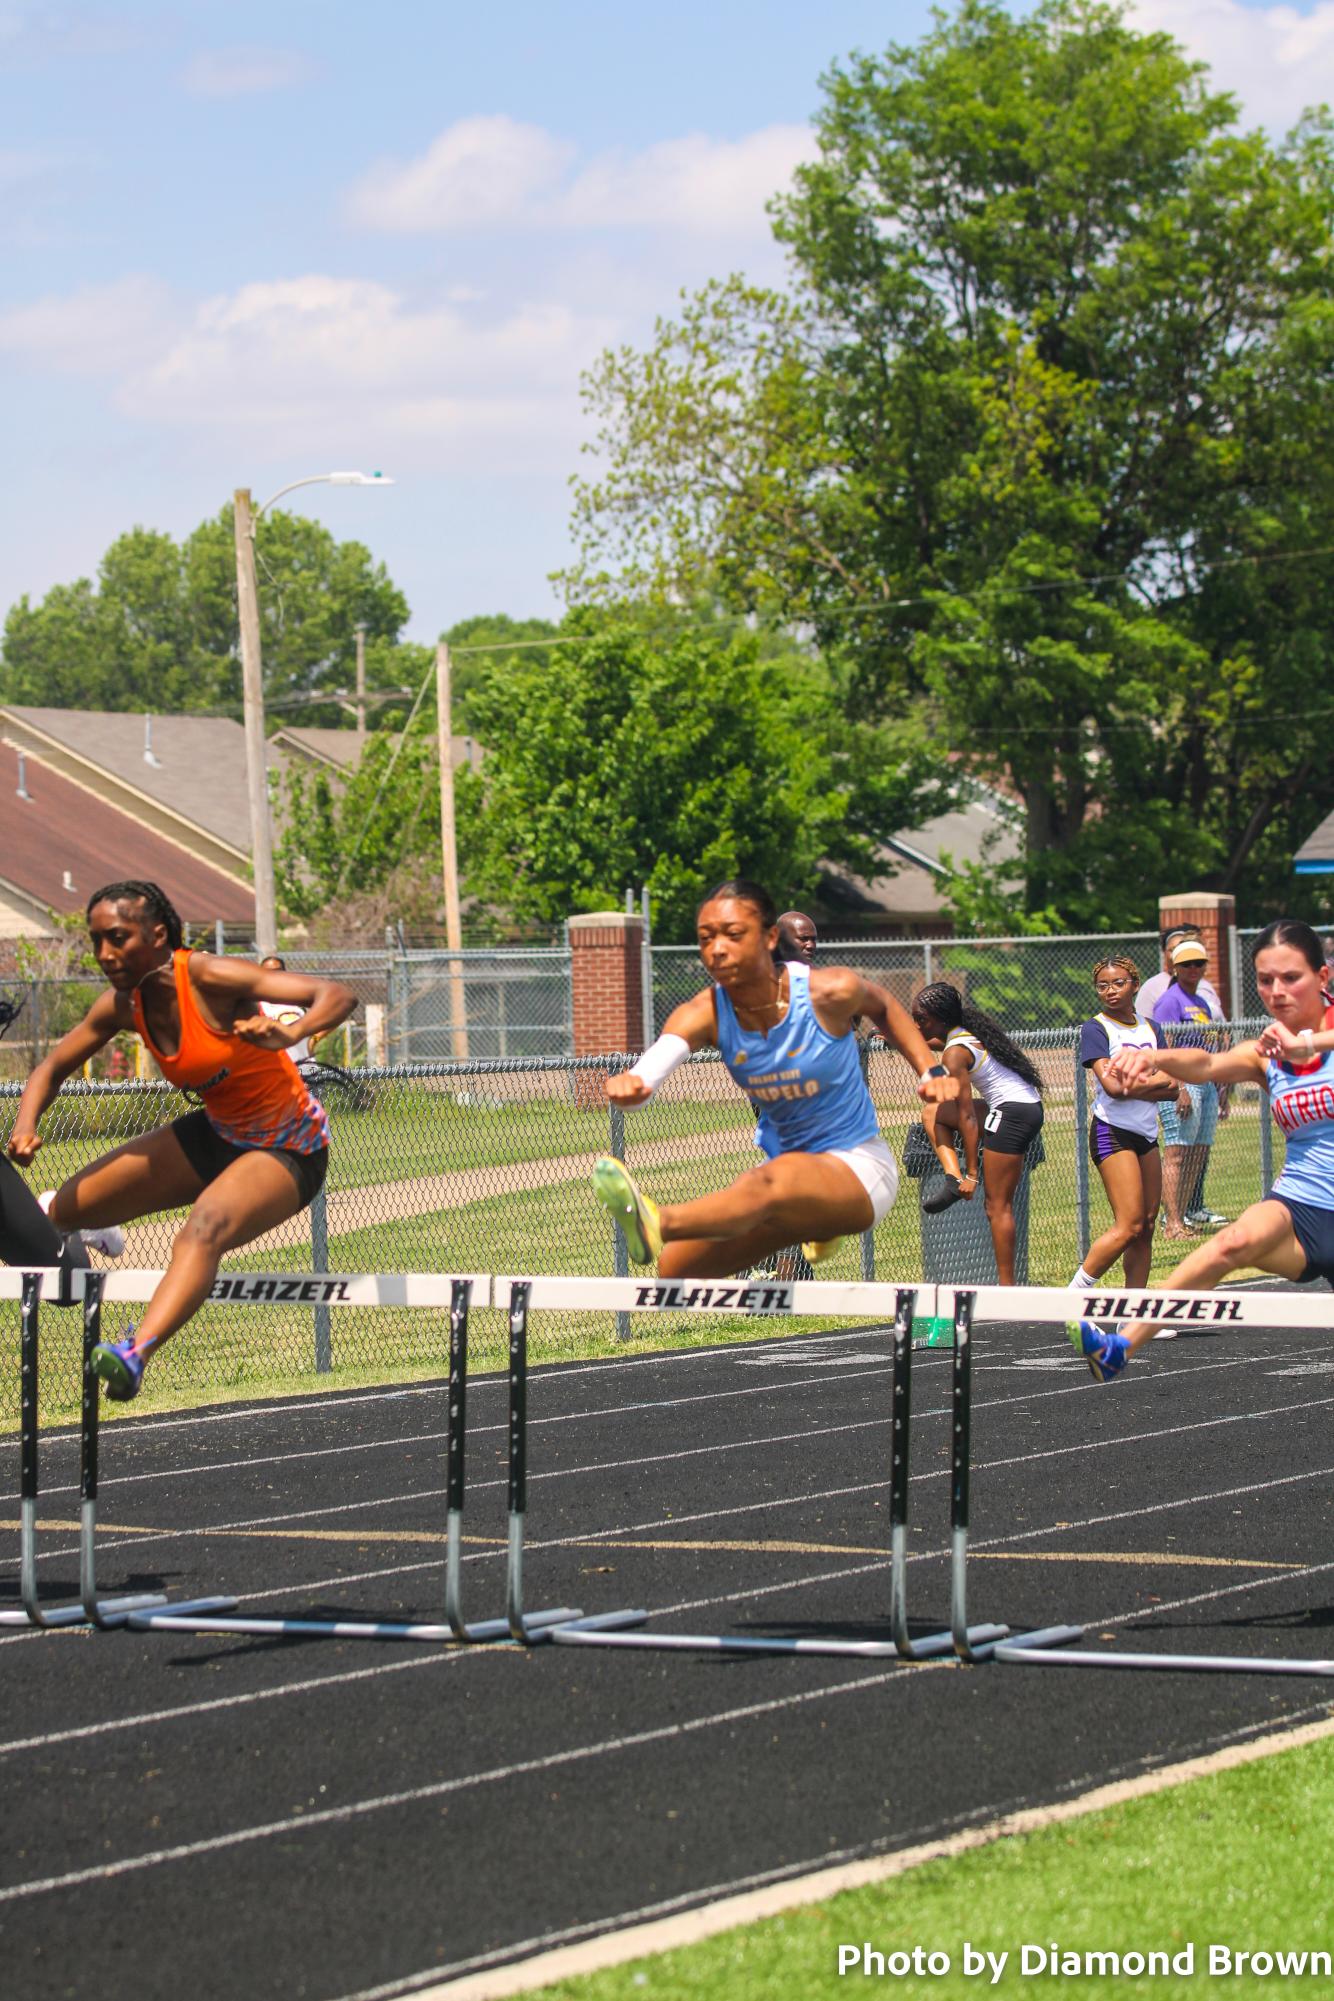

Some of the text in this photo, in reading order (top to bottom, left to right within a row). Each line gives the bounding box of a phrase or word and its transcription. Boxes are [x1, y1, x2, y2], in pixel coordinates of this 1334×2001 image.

[1271, 1084, 1334, 1132] ATRIO
[987, 1110, 998, 1129] 1
[206, 1279, 351, 1301] BLAZER
[635, 1287, 791, 1309] BLAZER
[1083, 1298, 1244, 1320] BLAZER
